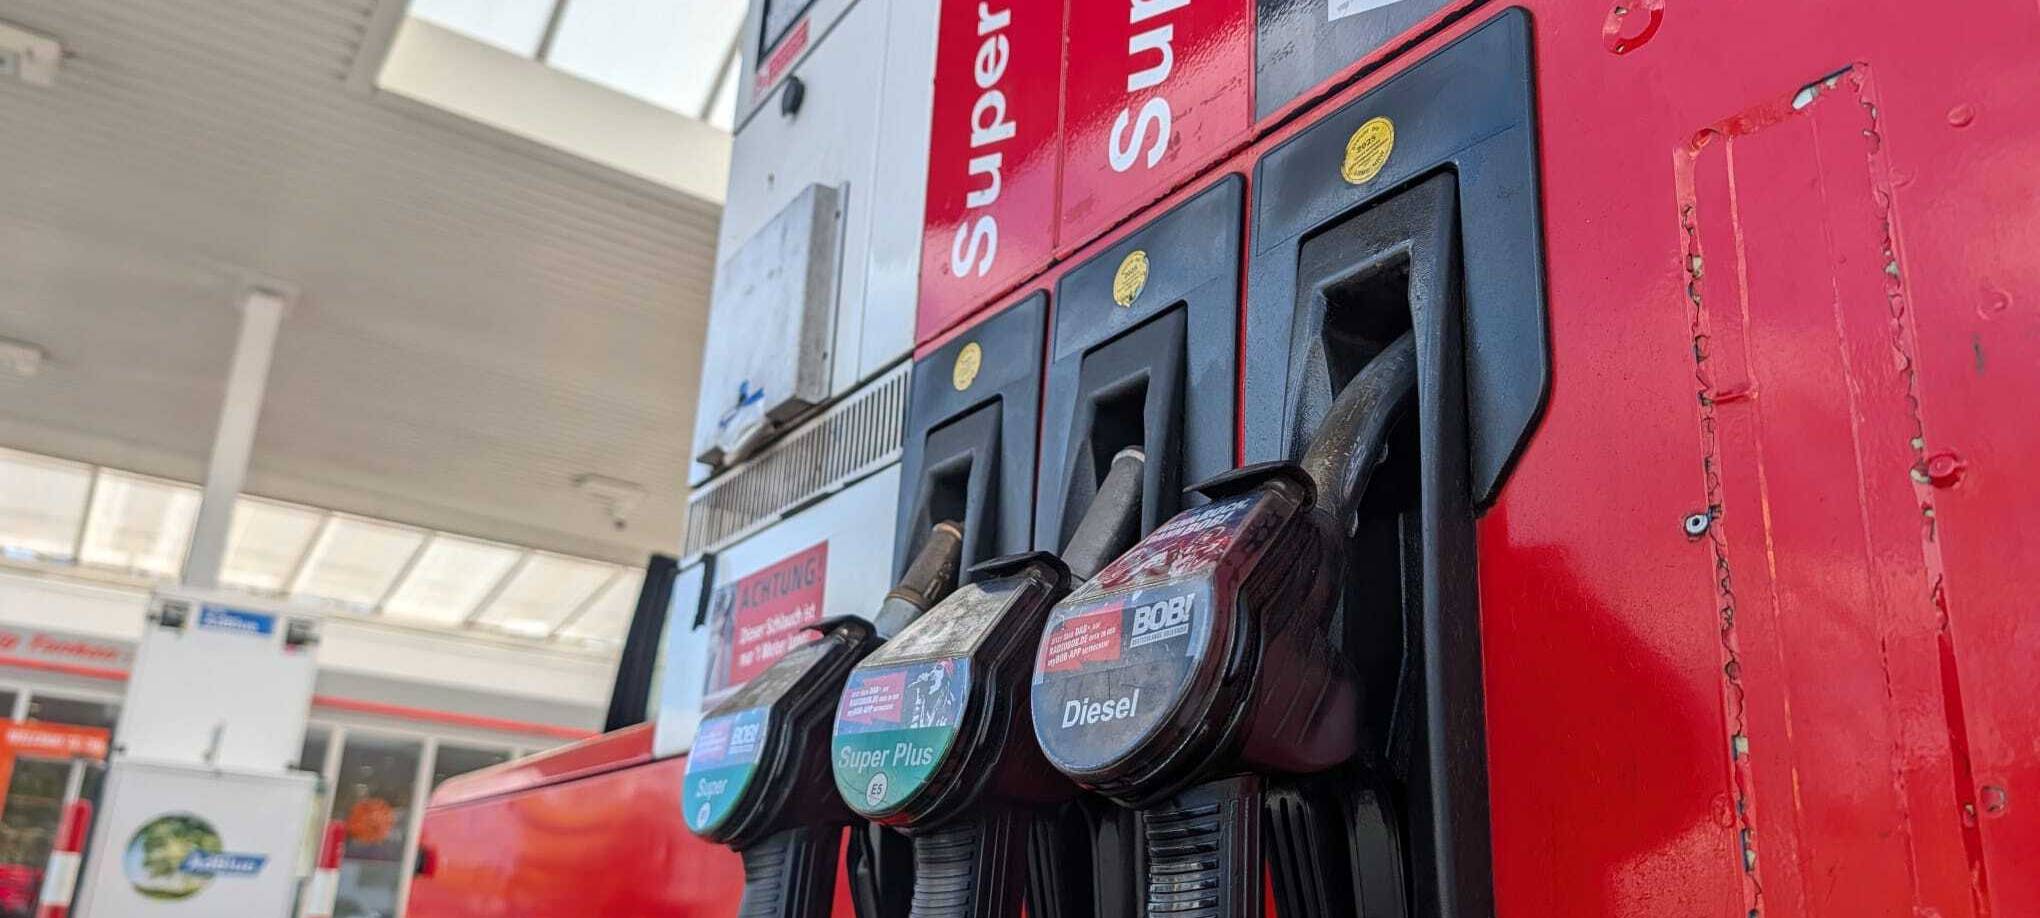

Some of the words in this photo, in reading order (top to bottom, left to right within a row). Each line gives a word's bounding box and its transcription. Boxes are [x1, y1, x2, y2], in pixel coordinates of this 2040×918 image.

[951, 1, 1017, 278] Super
[1131, 593, 1196, 636] BOB!
[1062, 688, 1140, 729] Diesel
[838, 745, 891, 774] Super
[892, 742, 934, 767] Plus
[696, 777, 729, 801] Super
[871, 783, 884, 796] E5
